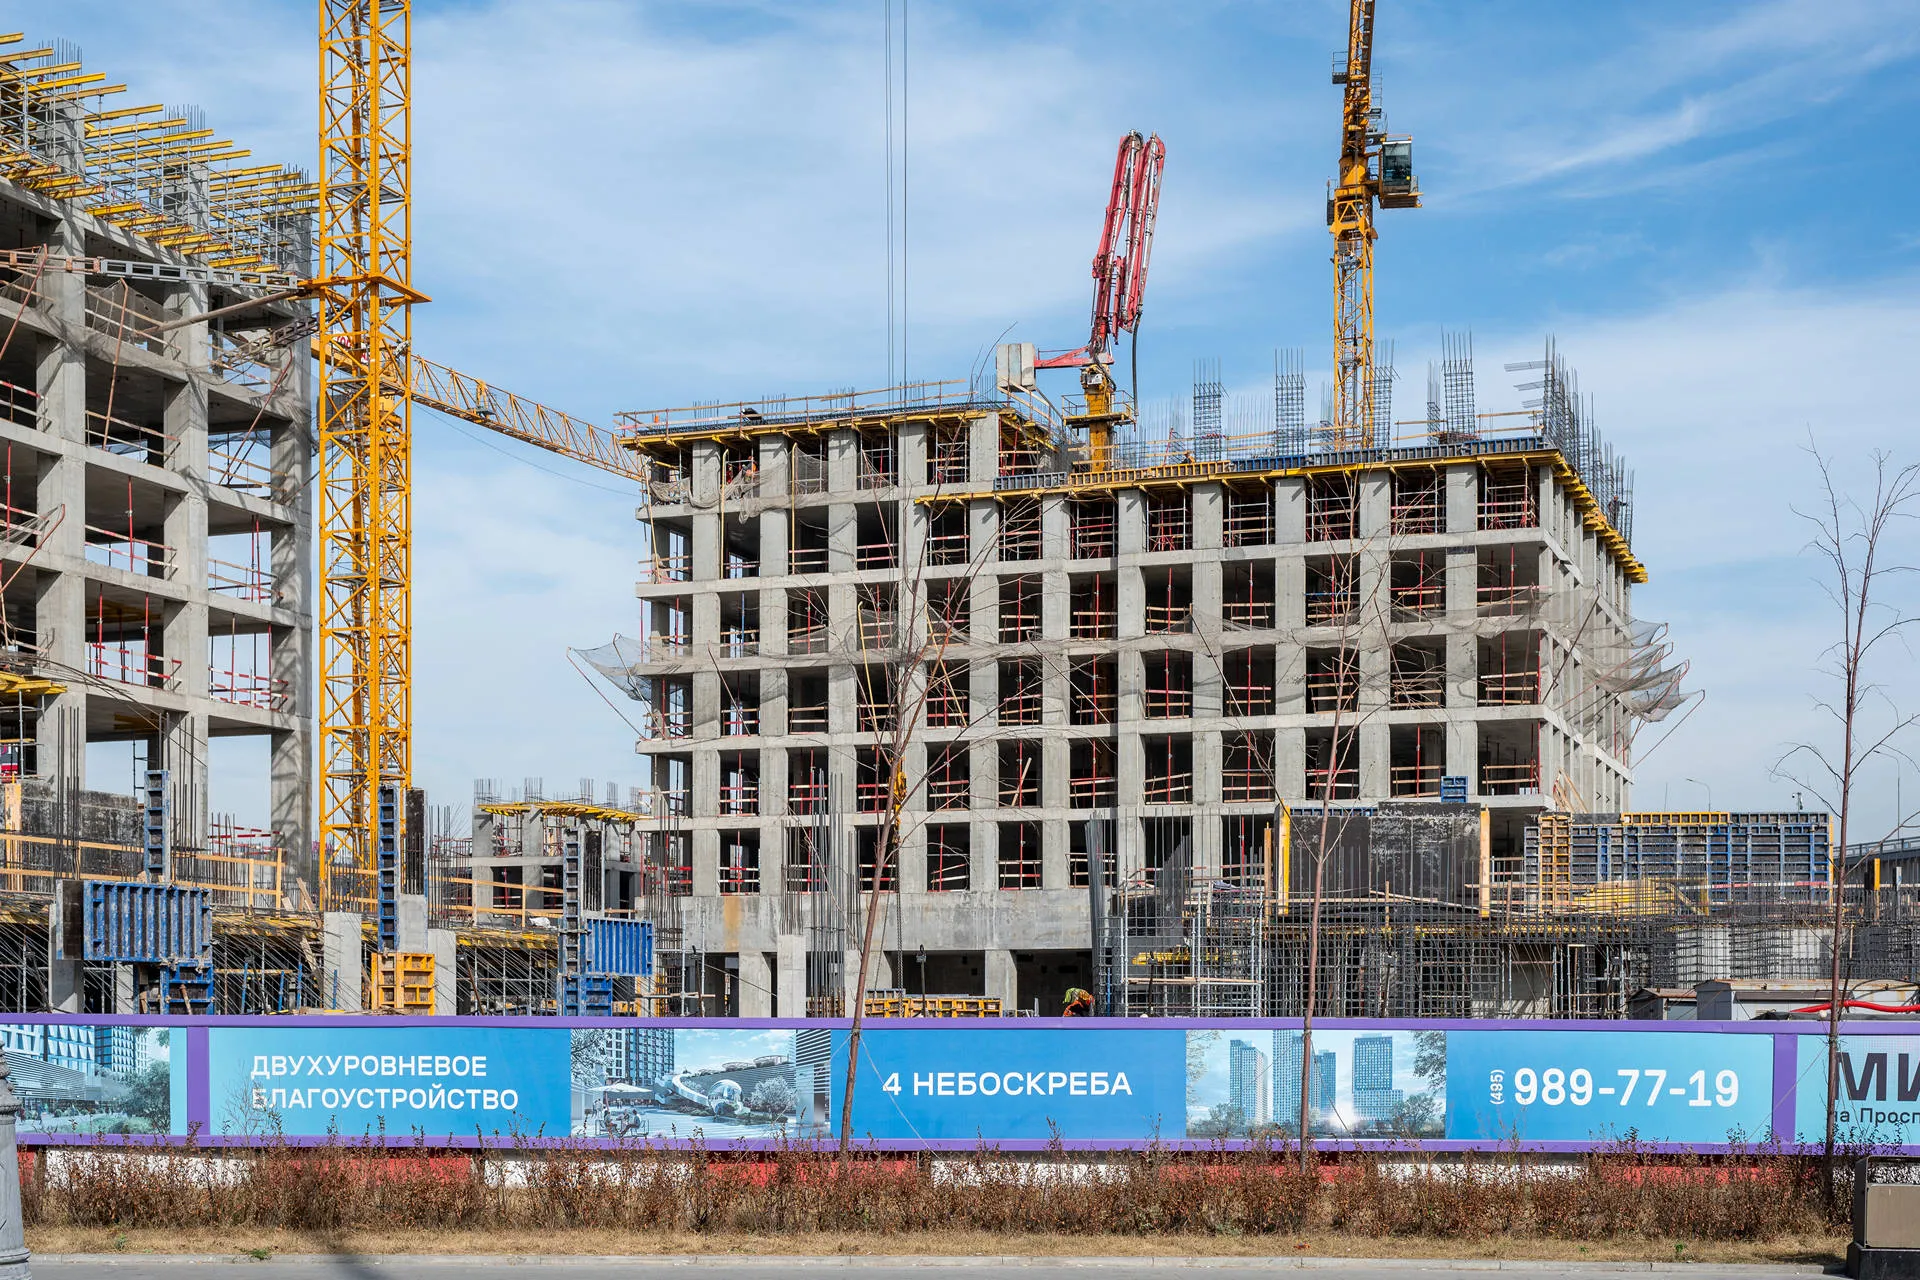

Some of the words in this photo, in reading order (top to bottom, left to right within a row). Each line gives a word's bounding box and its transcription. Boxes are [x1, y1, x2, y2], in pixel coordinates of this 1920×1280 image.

[250, 1055, 488, 1080] ДВУХУРОВНЕВОЕ
[252, 1083, 519, 1110] БЛАГОУСТРОЙСТВО
[882, 1072, 902, 1096] 4
[912, 1072, 1133, 1096] НЕБОСКРЕБА
[1489, 1069, 1505, 1105] (495)
[1514, 1067, 1740, 1107] 989-77-19
